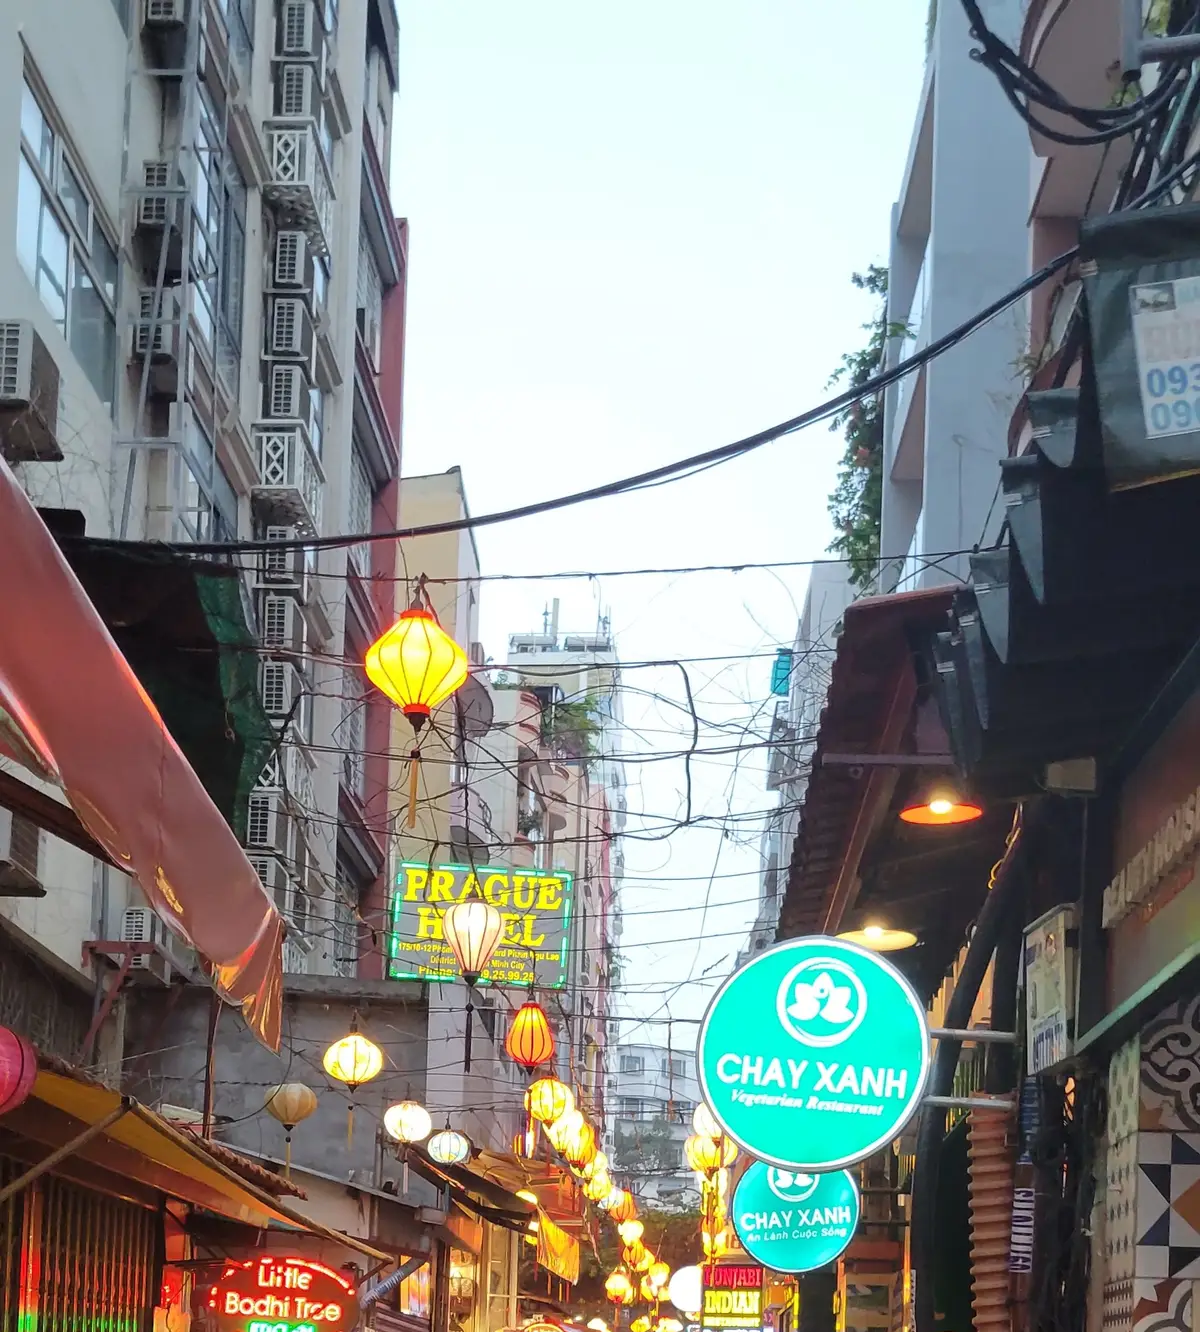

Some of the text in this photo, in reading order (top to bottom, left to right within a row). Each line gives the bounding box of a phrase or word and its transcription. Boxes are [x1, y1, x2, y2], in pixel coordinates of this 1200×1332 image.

[404, 869, 563, 910] PRAGUE
[416, 907, 545, 946] HEL
[511, 960, 525, 971] City
[716, 1053, 908, 1099] CHAY XANH
[731, 1089, 884, 1116] Vegetarian Restaurant
[740, 1205, 851, 1231] CHAY XANH
[258, 1264, 312, 1290] Little
[225, 1291, 341, 1321] Bodhi Tree
[705, 1291, 760, 1314] INDIAN
